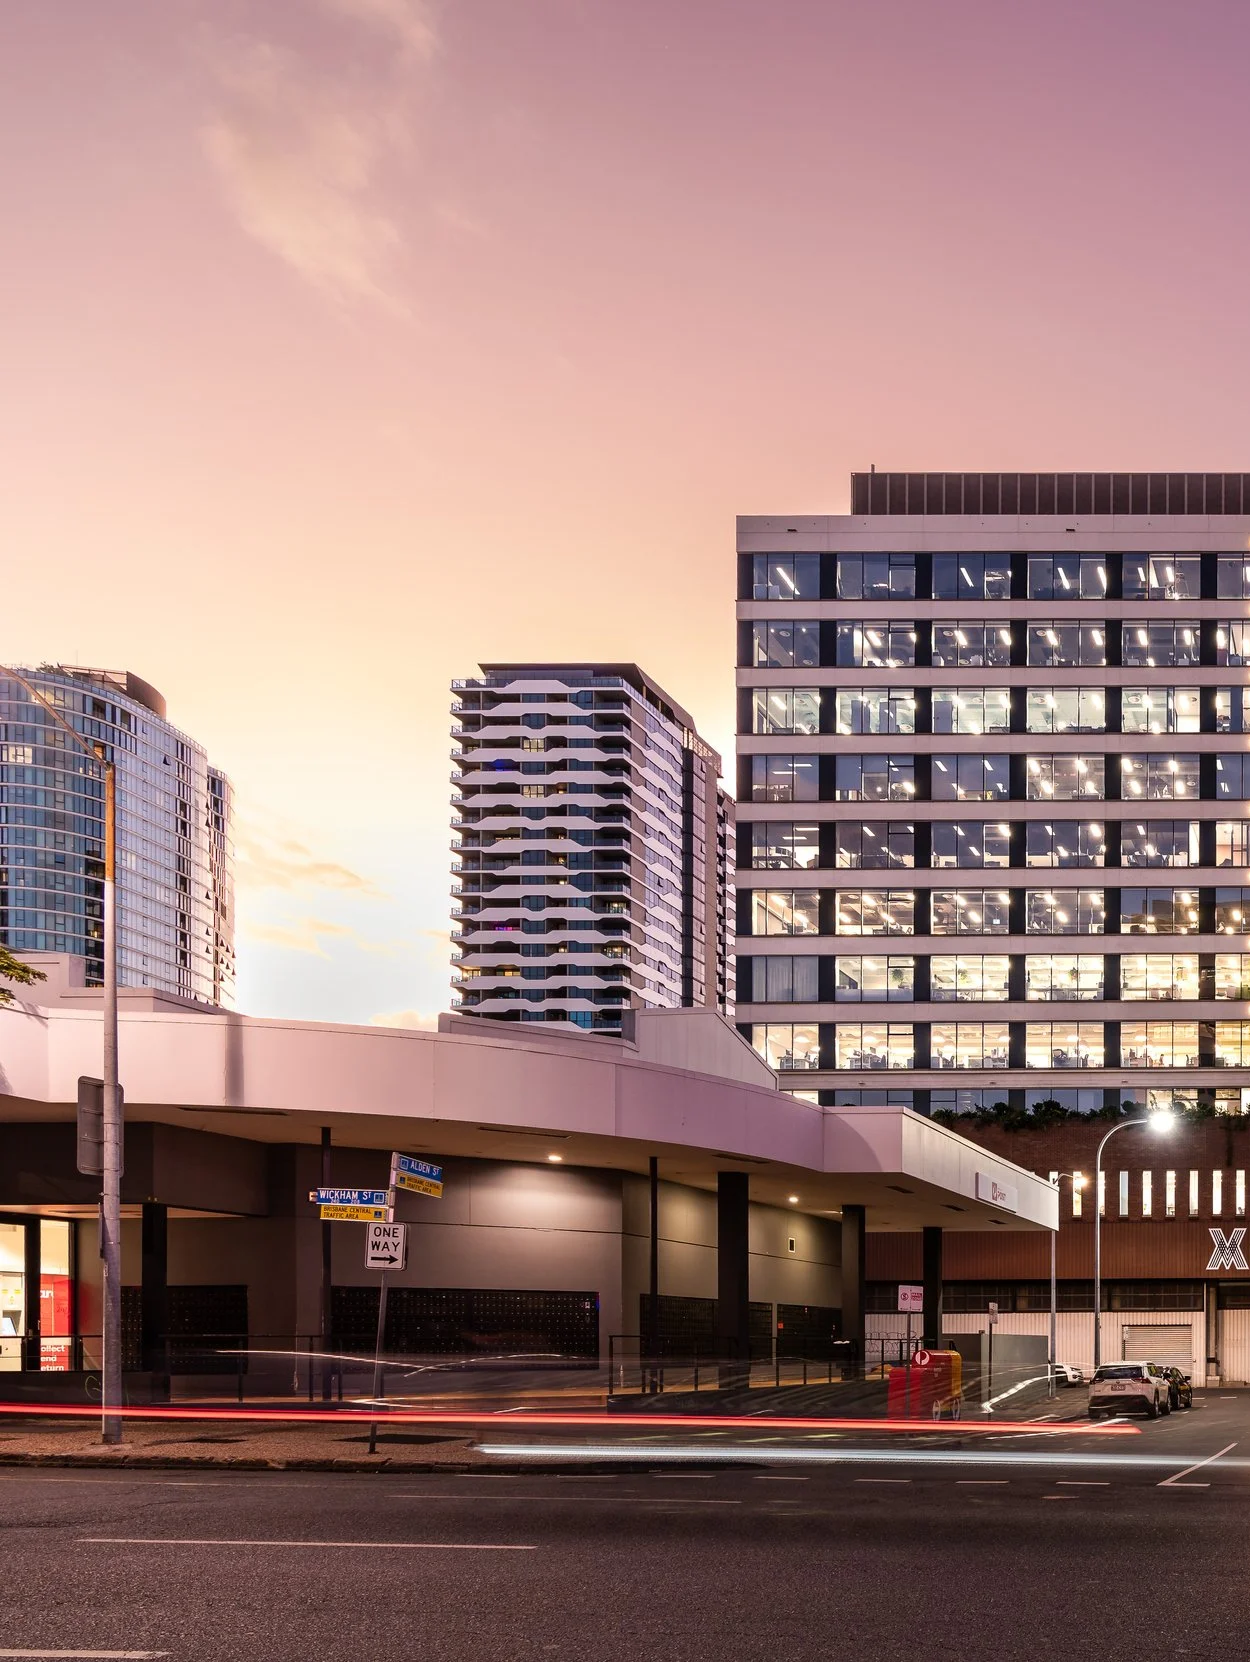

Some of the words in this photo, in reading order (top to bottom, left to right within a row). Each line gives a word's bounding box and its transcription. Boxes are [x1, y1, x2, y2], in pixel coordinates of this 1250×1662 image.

[410, 1160, 430, 1174] ALDEN
[432, 1167, 440, 1176] ST
[320, 1190, 358, 1200] WICKHAM
[362, 1191, 372, 1200] ST
[373, 1226, 399, 1238] ONE
[371, 1240, 400, 1252] WAY
